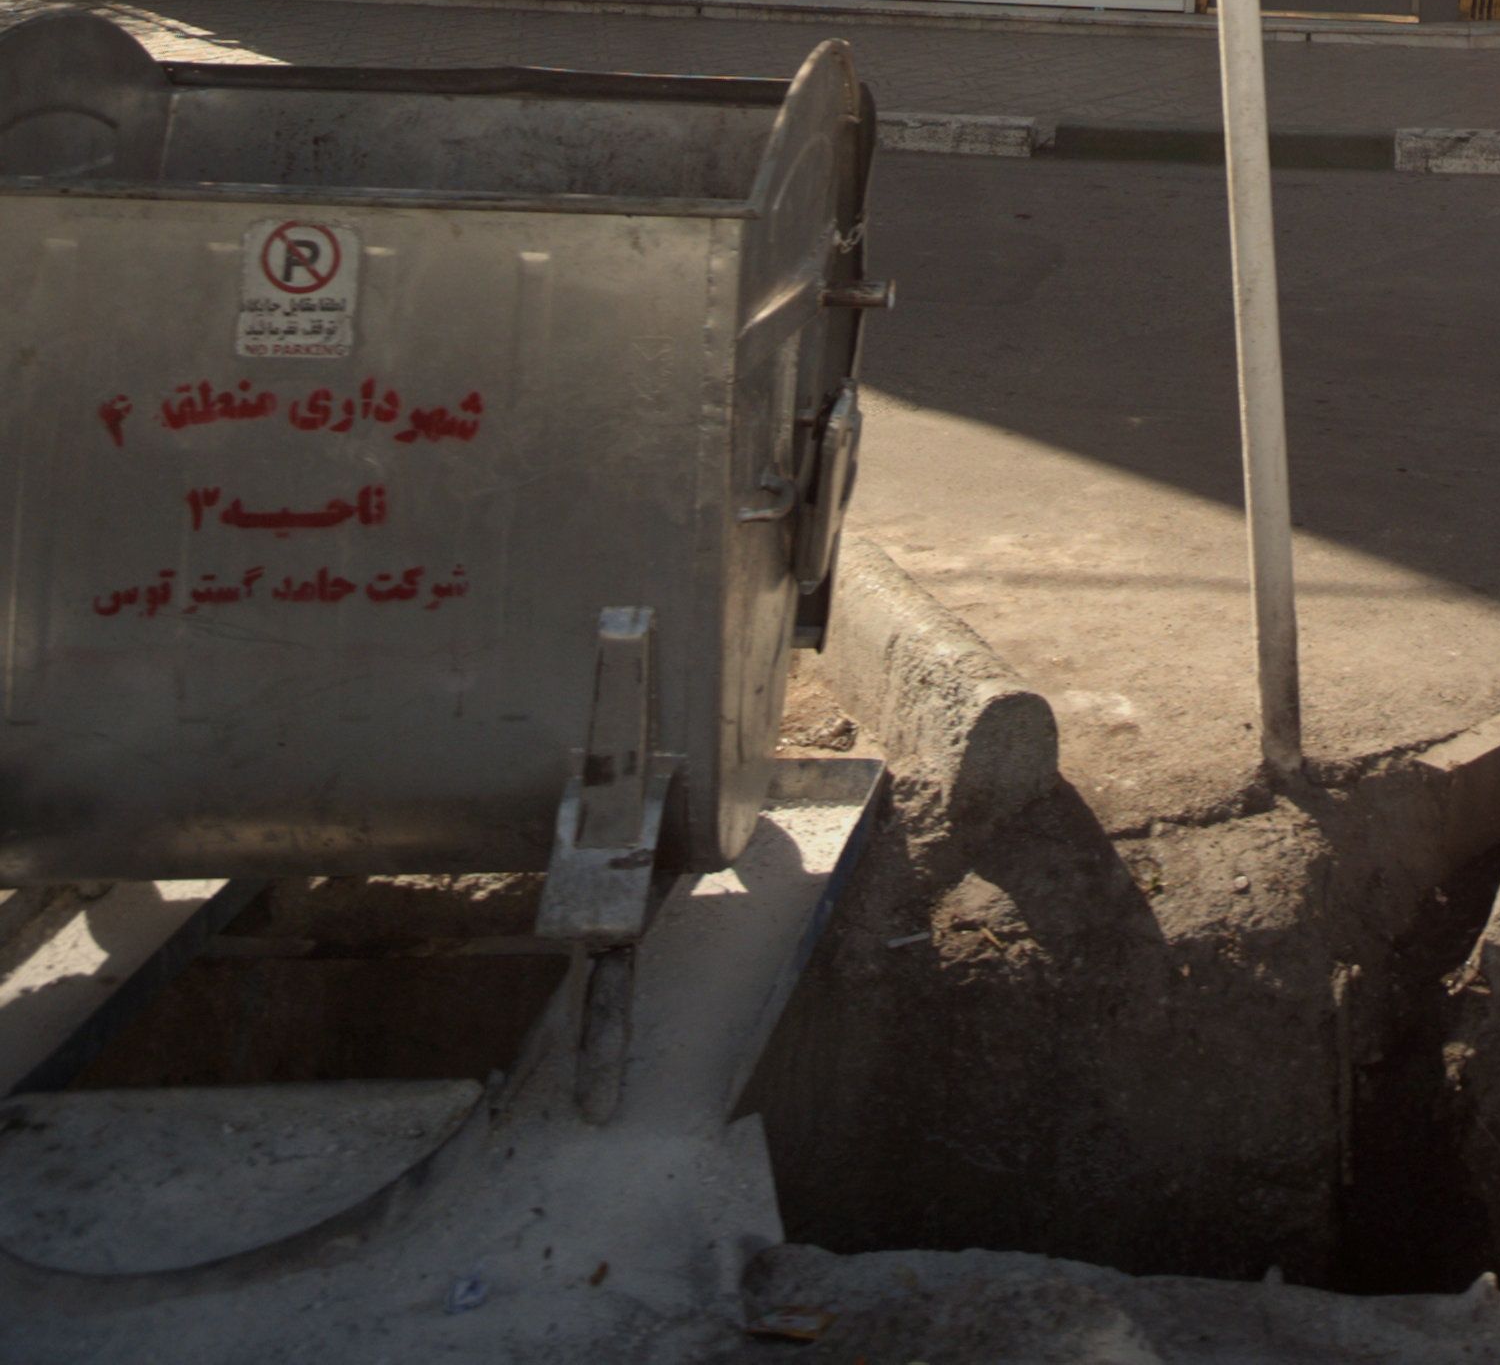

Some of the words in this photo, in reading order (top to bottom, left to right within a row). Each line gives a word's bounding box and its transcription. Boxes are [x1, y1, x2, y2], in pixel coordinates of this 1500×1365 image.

[244, 343, 268, 355] NO
[271, 343, 347, 357] PARKING
[364, 563, 473, 612] شرکت
